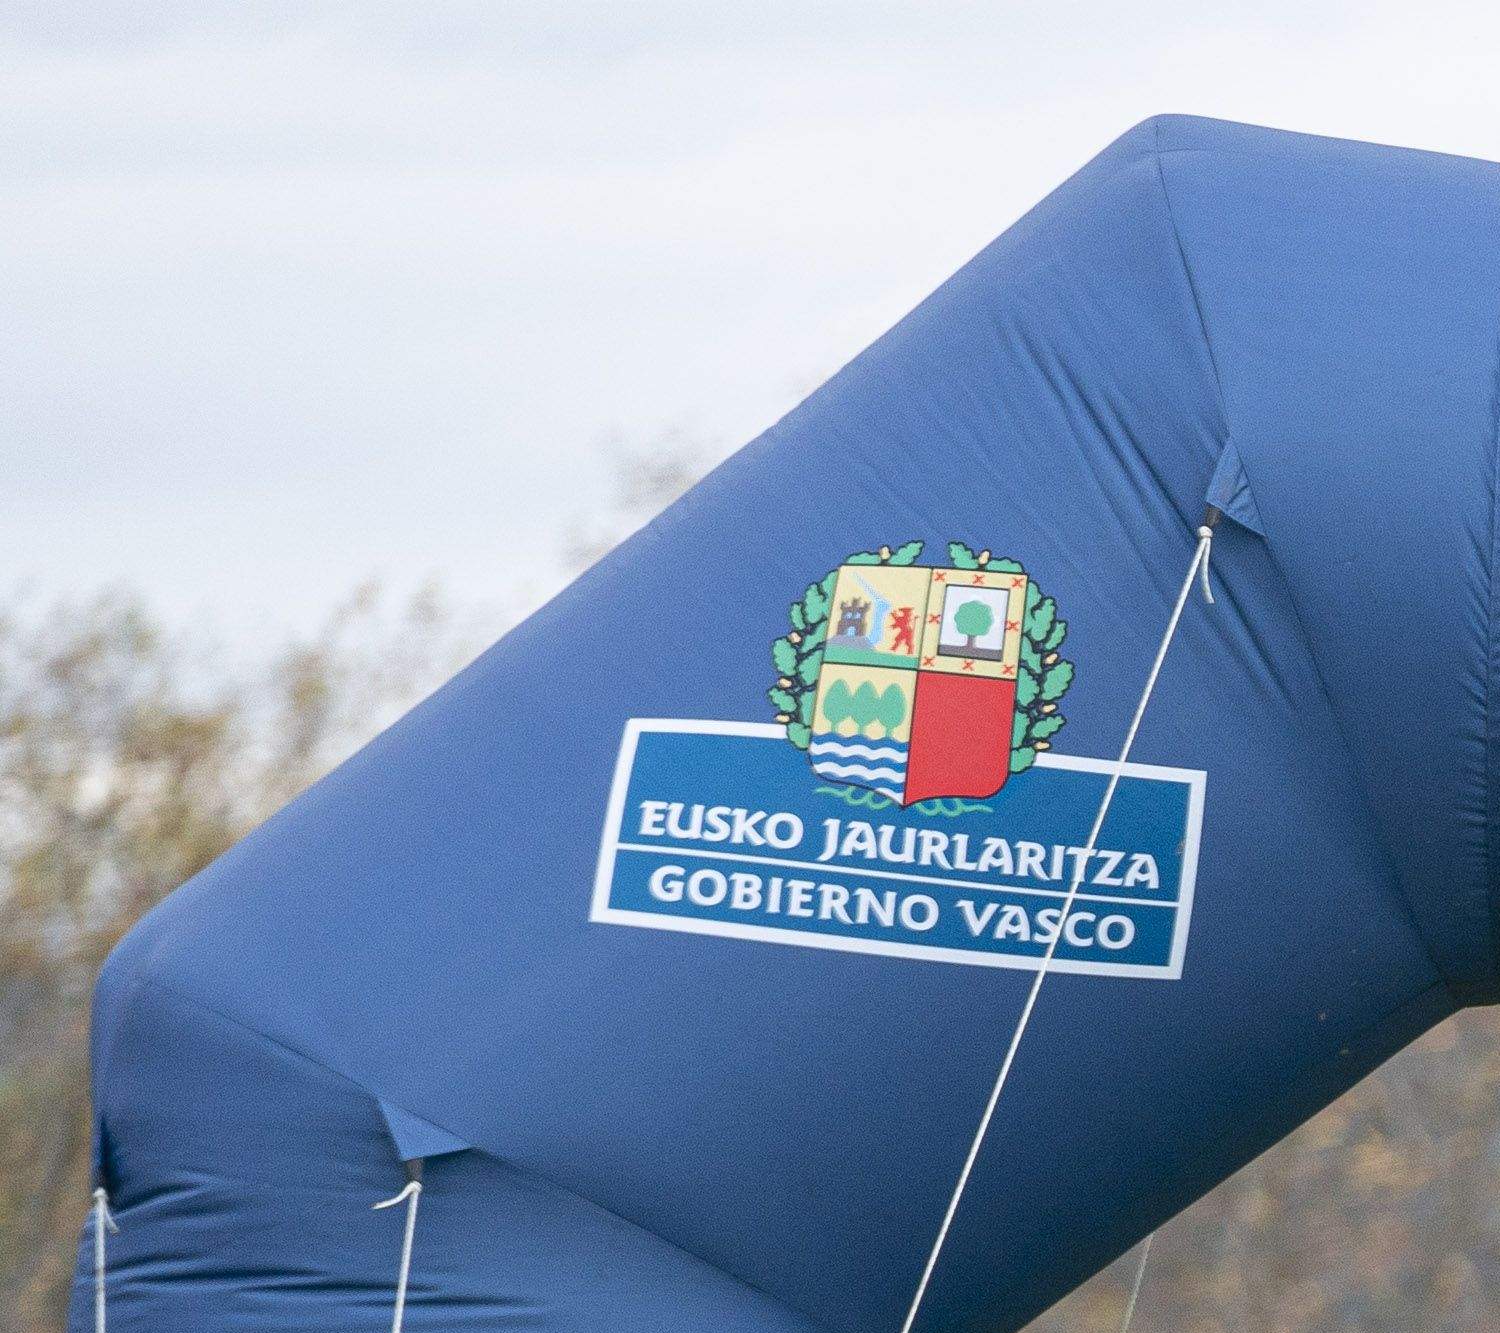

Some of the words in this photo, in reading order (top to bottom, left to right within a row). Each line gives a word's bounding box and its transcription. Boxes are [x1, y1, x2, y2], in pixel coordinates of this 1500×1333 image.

[638, 800, 804, 850] EUSKO
[817, 817, 1161, 891] JAURLARITZA
[648, 864, 941, 932] GOBIERNO
[954, 899, 1137, 951] VASCO
